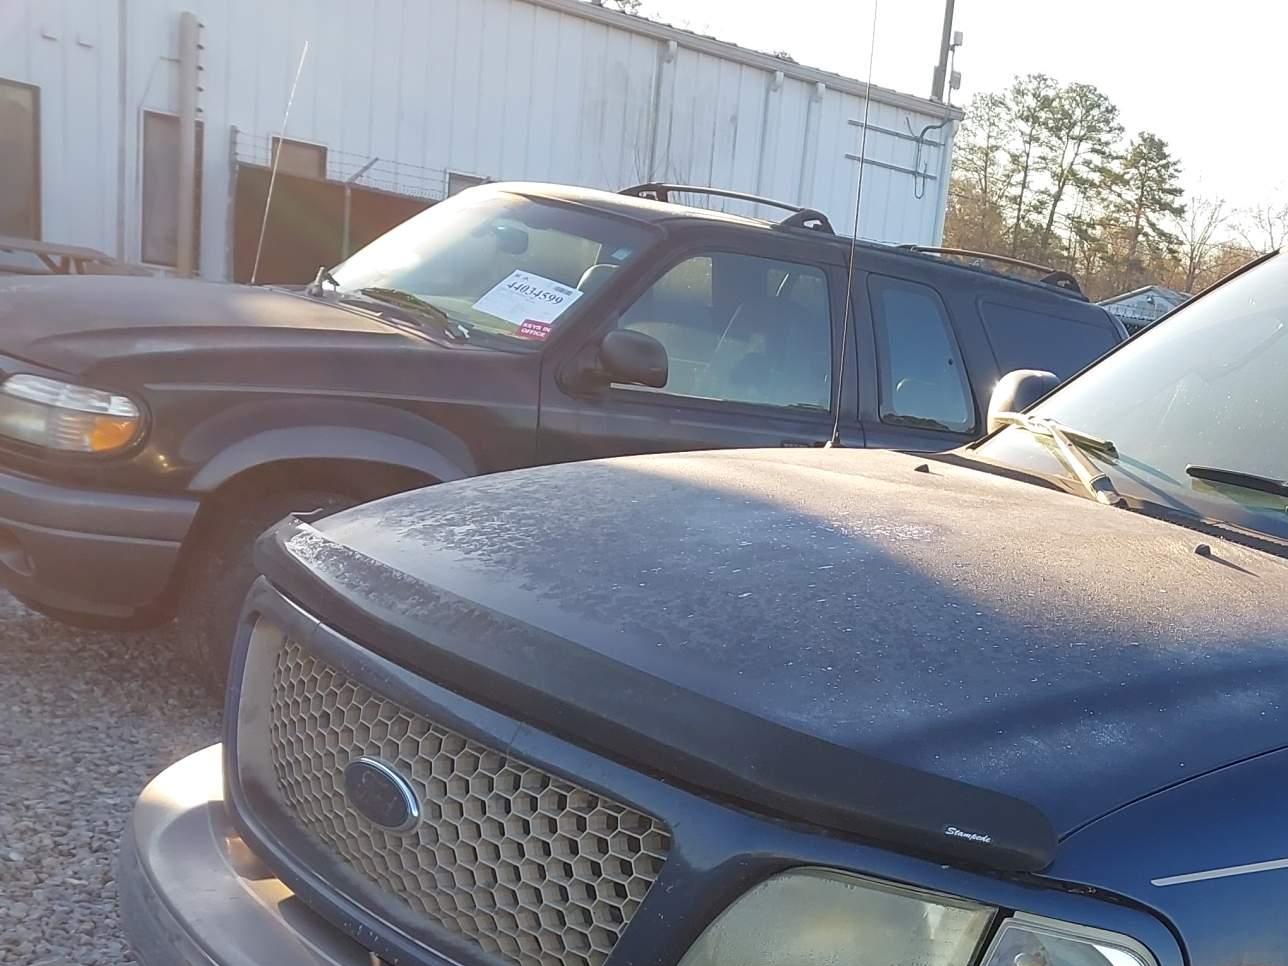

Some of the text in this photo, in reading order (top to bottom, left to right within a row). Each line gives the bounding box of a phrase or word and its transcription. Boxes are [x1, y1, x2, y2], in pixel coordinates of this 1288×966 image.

[507, 281, 564, 304] 44034599
[520, 328, 546, 338] OFFICE
[522, 322, 542, 331] KEYS
[945, 826, 991, 843] Stampede
